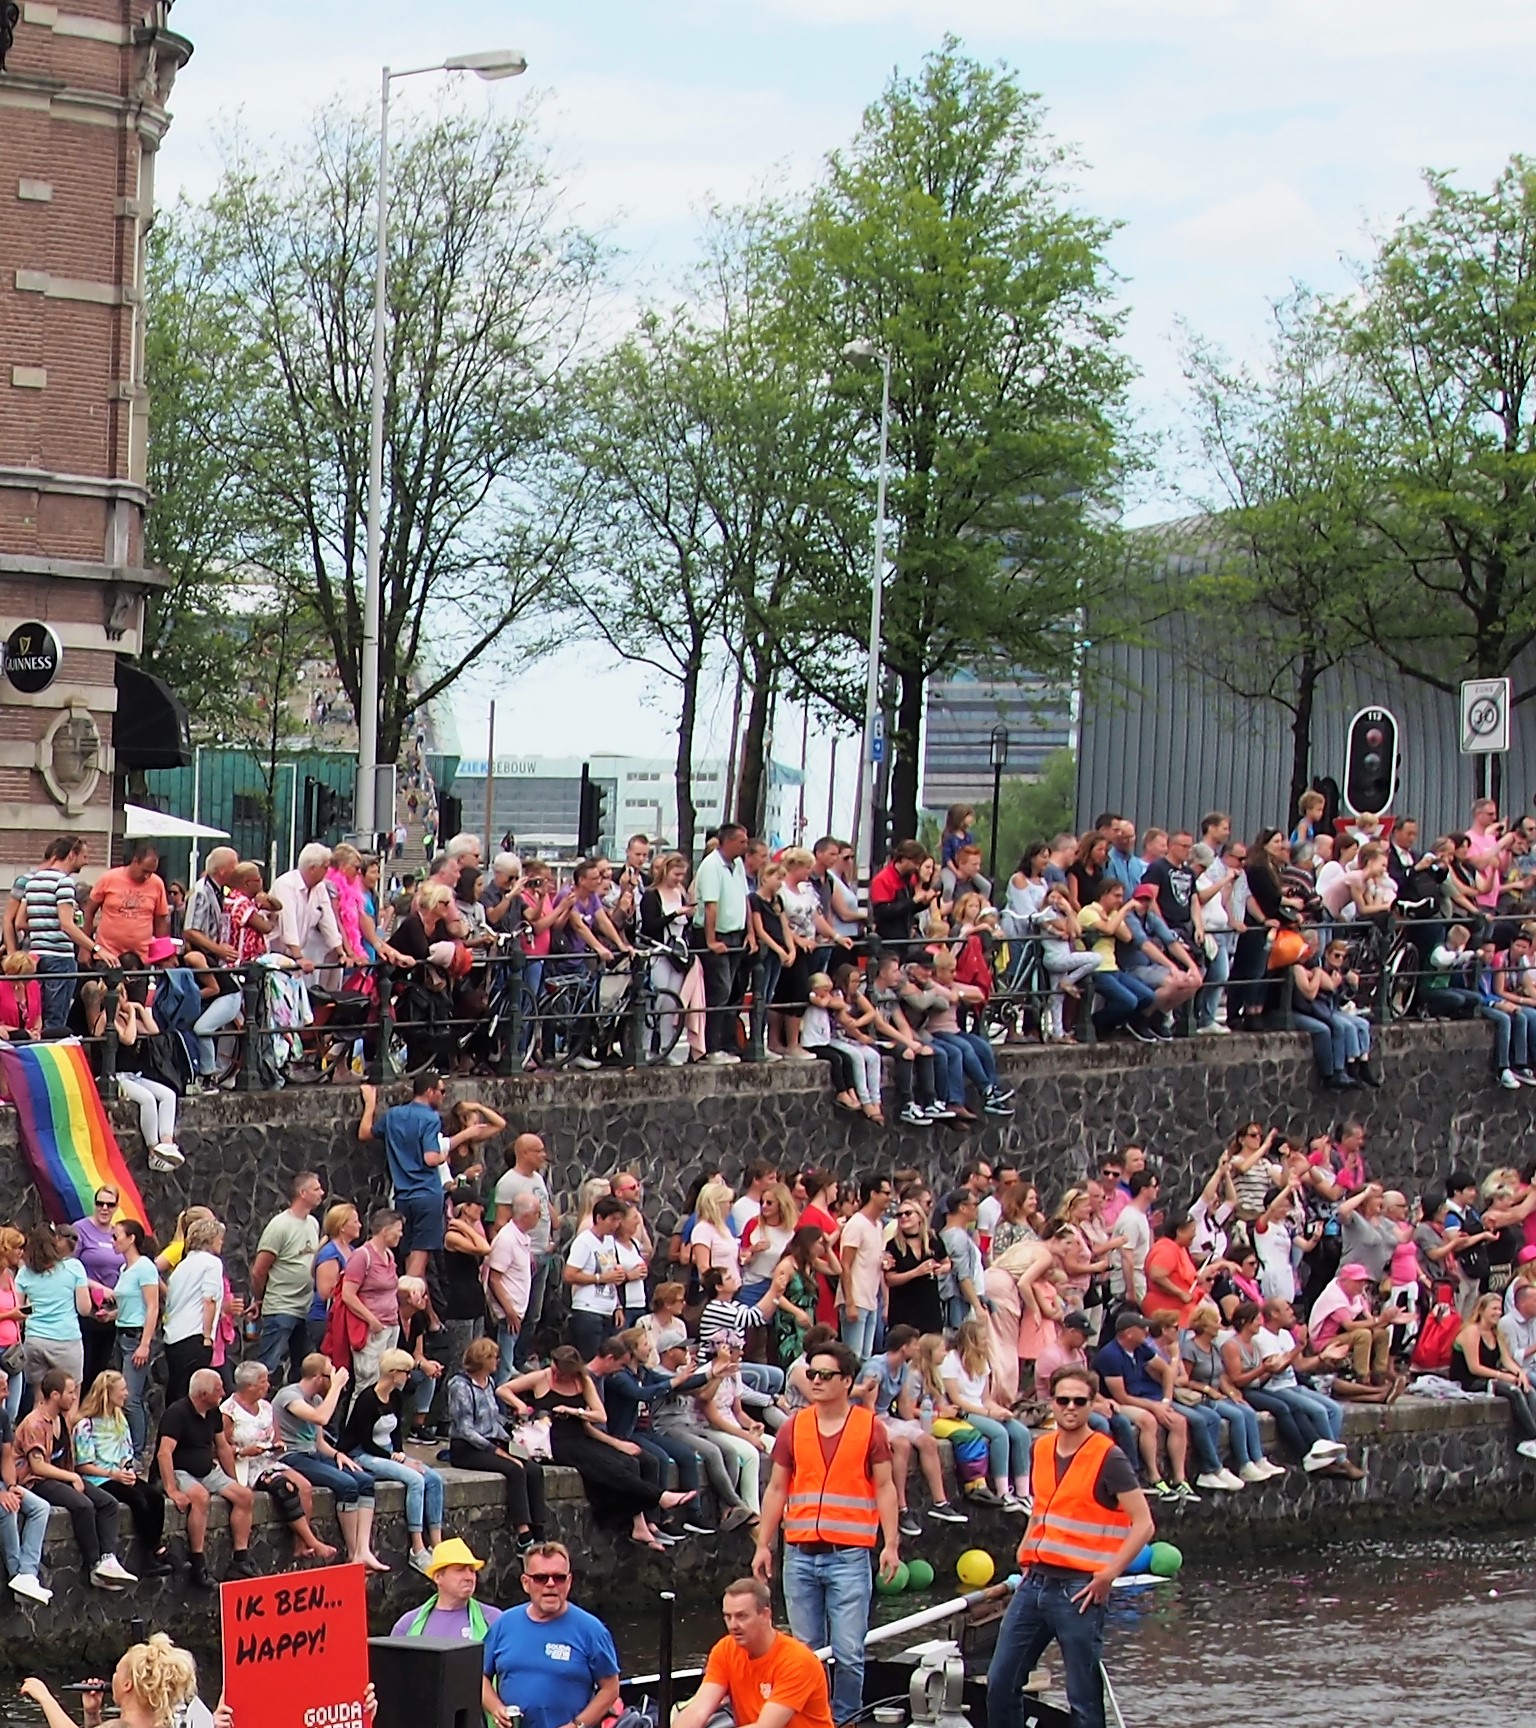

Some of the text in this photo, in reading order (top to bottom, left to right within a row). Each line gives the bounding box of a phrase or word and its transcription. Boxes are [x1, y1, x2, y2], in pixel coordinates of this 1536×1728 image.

[4, 653, 53, 671] GUINNESS
[236, 1584, 342, 1622] IK BEN...
[235, 1622, 327, 1665] HAPPY!
[304, 1701, 362, 1728] GOUDA
